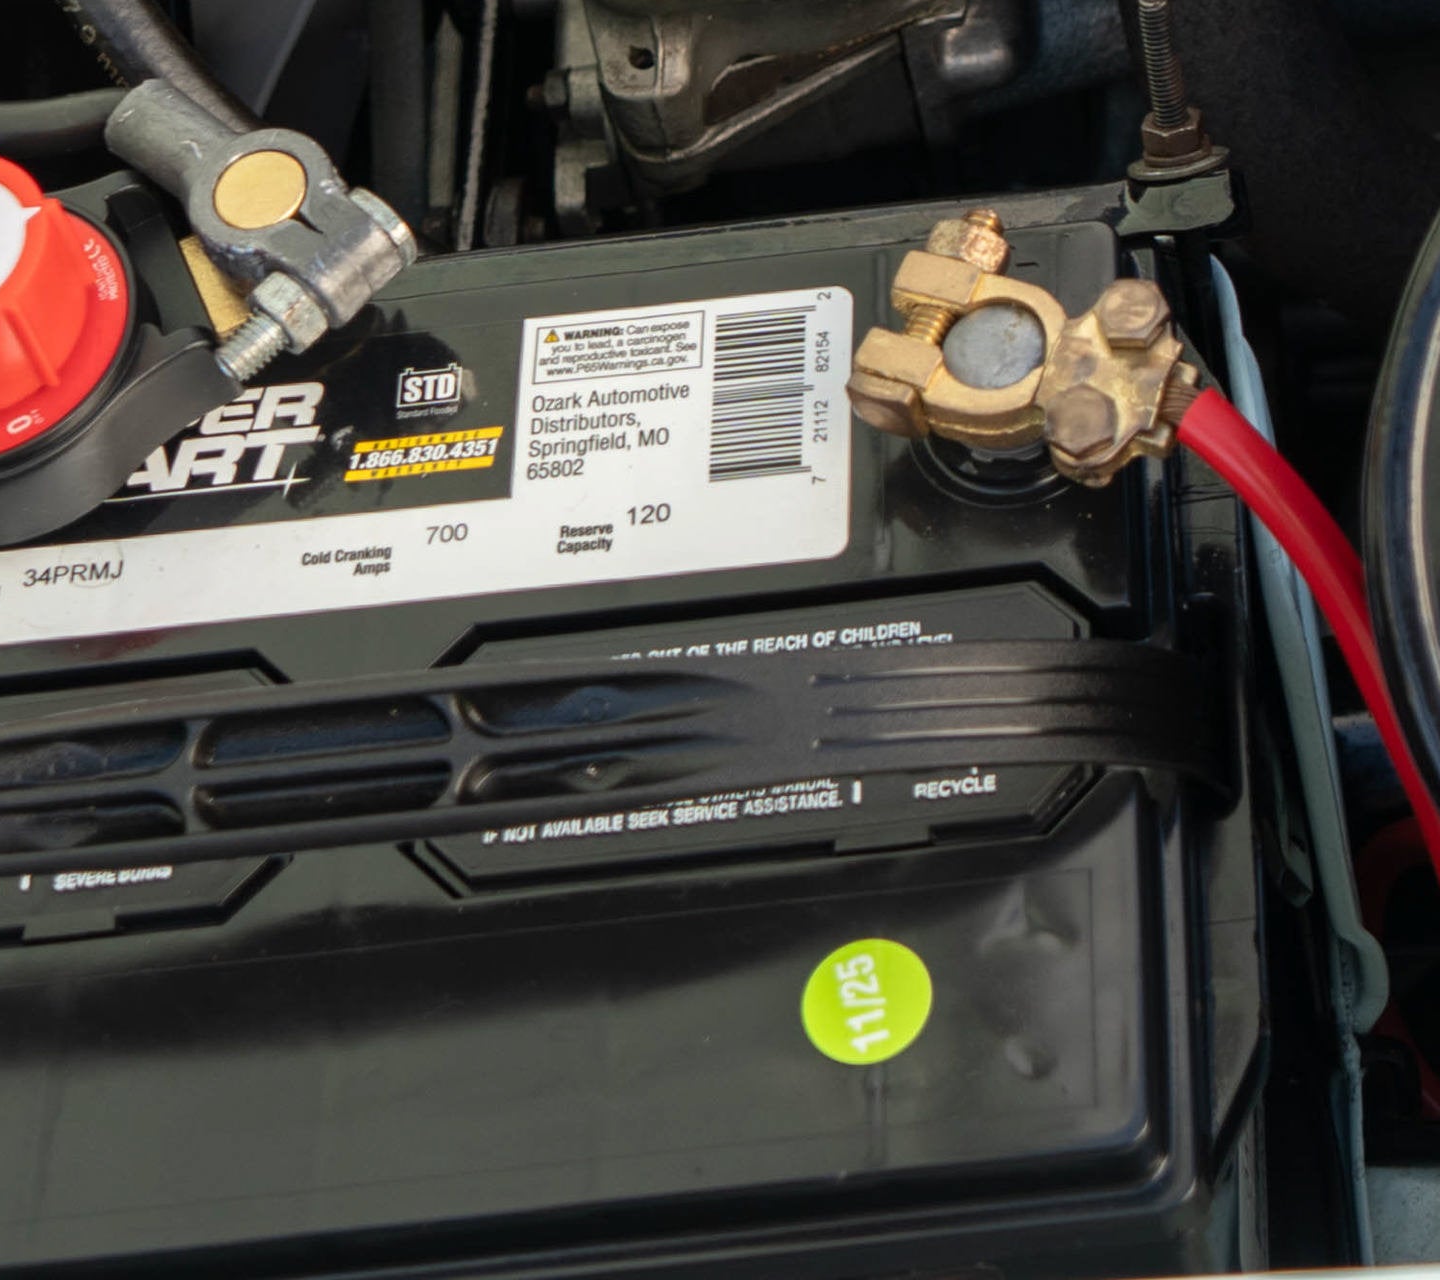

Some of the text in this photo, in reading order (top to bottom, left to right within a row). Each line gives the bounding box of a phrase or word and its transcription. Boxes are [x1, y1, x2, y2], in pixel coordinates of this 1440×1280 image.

[551, 343, 572, 355] you
[574, 342, 585, 351] to
[627, 332, 686, 346] carcinogen
[564, 320, 690, 341] WARNING: Can expose
[539, 355, 560, 366] and
[562, 347, 627, 364] reproductive
[676, 341, 697, 352] See
[403, 373, 456, 403] STD
[532, 382, 690, 413] Ozark Automotive
[811, 291, 832, 485] 7 21112 82154 2
[396, 407, 428, 419] Standard
[530, 409, 642, 436] Distributors,
[349, 437, 500, 471] 1.866.830.4351
[528, 427, 669, 460] Springfield, MO
[126, 426, 321, 491] ART
[527, 458, 585, 480] 65802
[626, 503, 672, 526] 120
[426, 522, 468, 545] 700
[559, 522, 614, 539] Reserve
[301, 545, 392, 566] Cold Cranking
[557, 537, 614, 555] Capacity
[23, 558, 124, 588] 34PRMJ
[353, 560, 391, 577] Amps
[715, 640, 748, 657] THE
[754, 634, 808, 655] REACH
[812, 630, 837, 648] OF
[841, 622, 921, 646] CHILDREN
[914, 774, 997, 800] RECYCLE
[542, 813, 624, 839] AVAILABLE
[628, 809, 669, 830] SEEK
[673, 801, 738, 827] SERVICE
[743, 789, 844, 815] ASSISTANCE.
[835, 954, 890, 1054] 11/25
